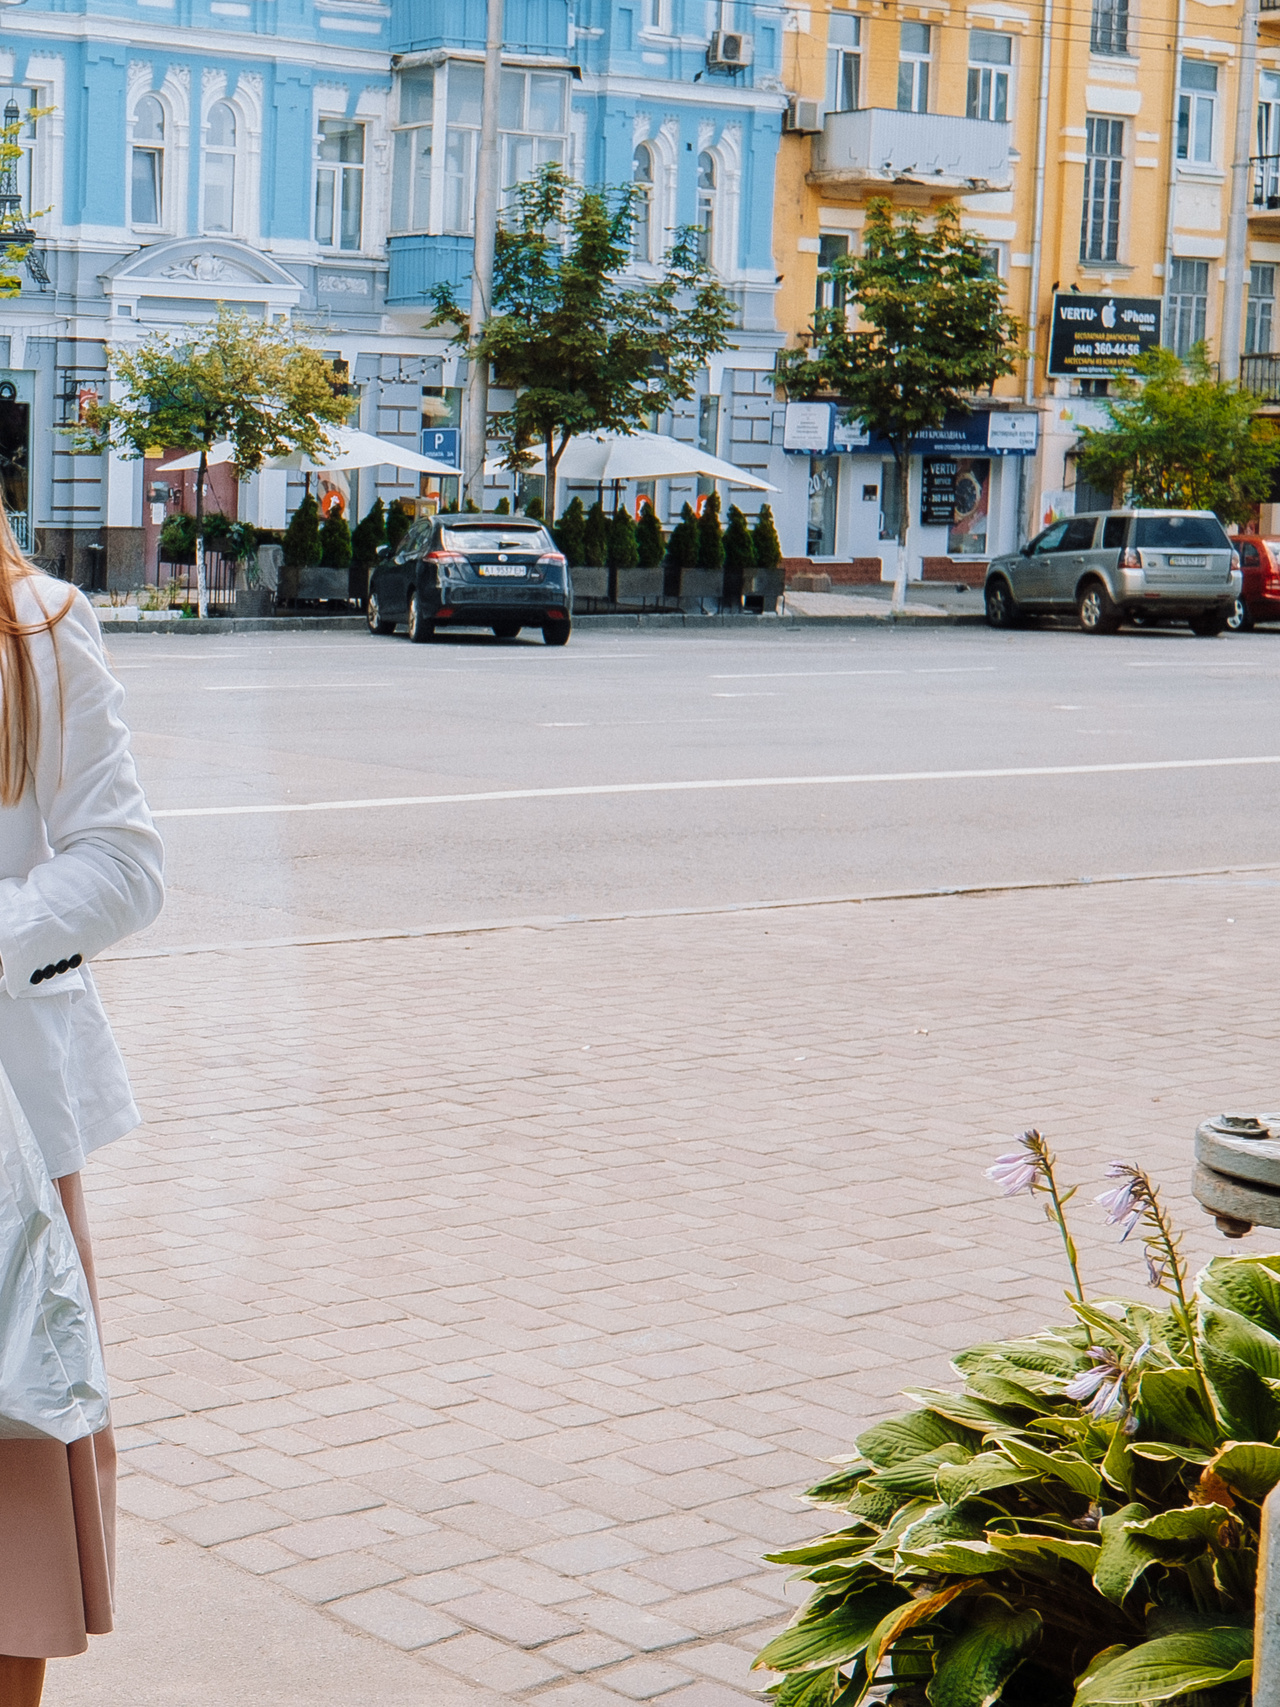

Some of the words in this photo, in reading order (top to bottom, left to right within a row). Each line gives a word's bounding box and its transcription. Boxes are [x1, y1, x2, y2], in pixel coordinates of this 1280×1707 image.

[1073, 344, 1092, 356] (044)
[1094, 342, 1140, 356] 360-44-56
[434, 432, 445, 450] P
[930, 463, 957, 475] VERTU
